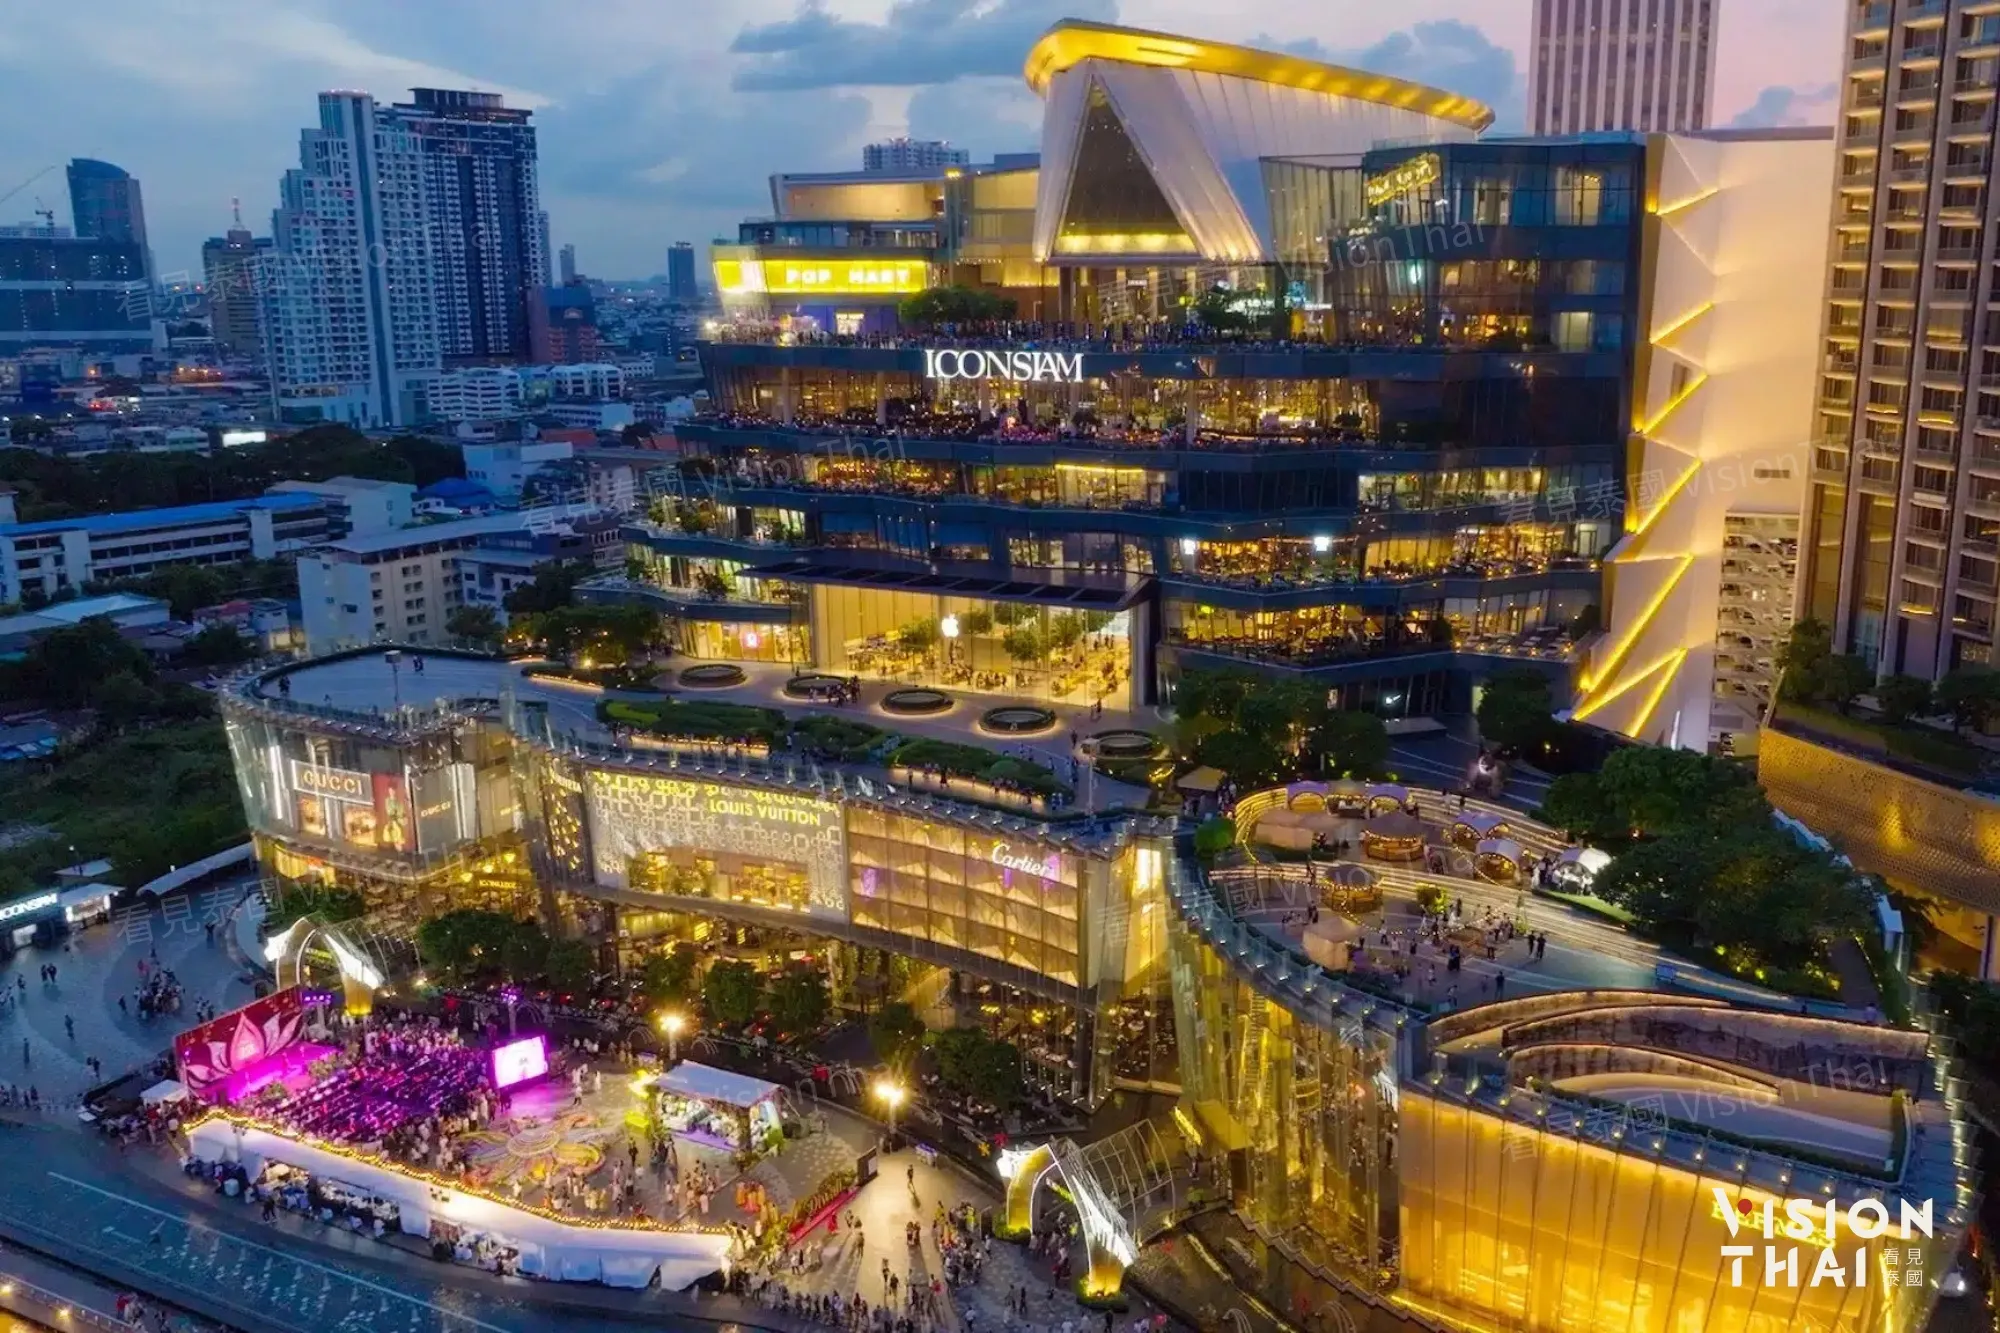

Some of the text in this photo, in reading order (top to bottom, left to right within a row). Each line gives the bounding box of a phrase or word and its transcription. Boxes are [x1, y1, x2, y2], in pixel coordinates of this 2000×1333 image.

[925, 349, 1084, 383] ICONSIAM
[303, 771, 363, 796] GUCCI
[710, 799, 821, 826] LOUIS VUITTON
[991, 843, 1054, 878] Cartier
